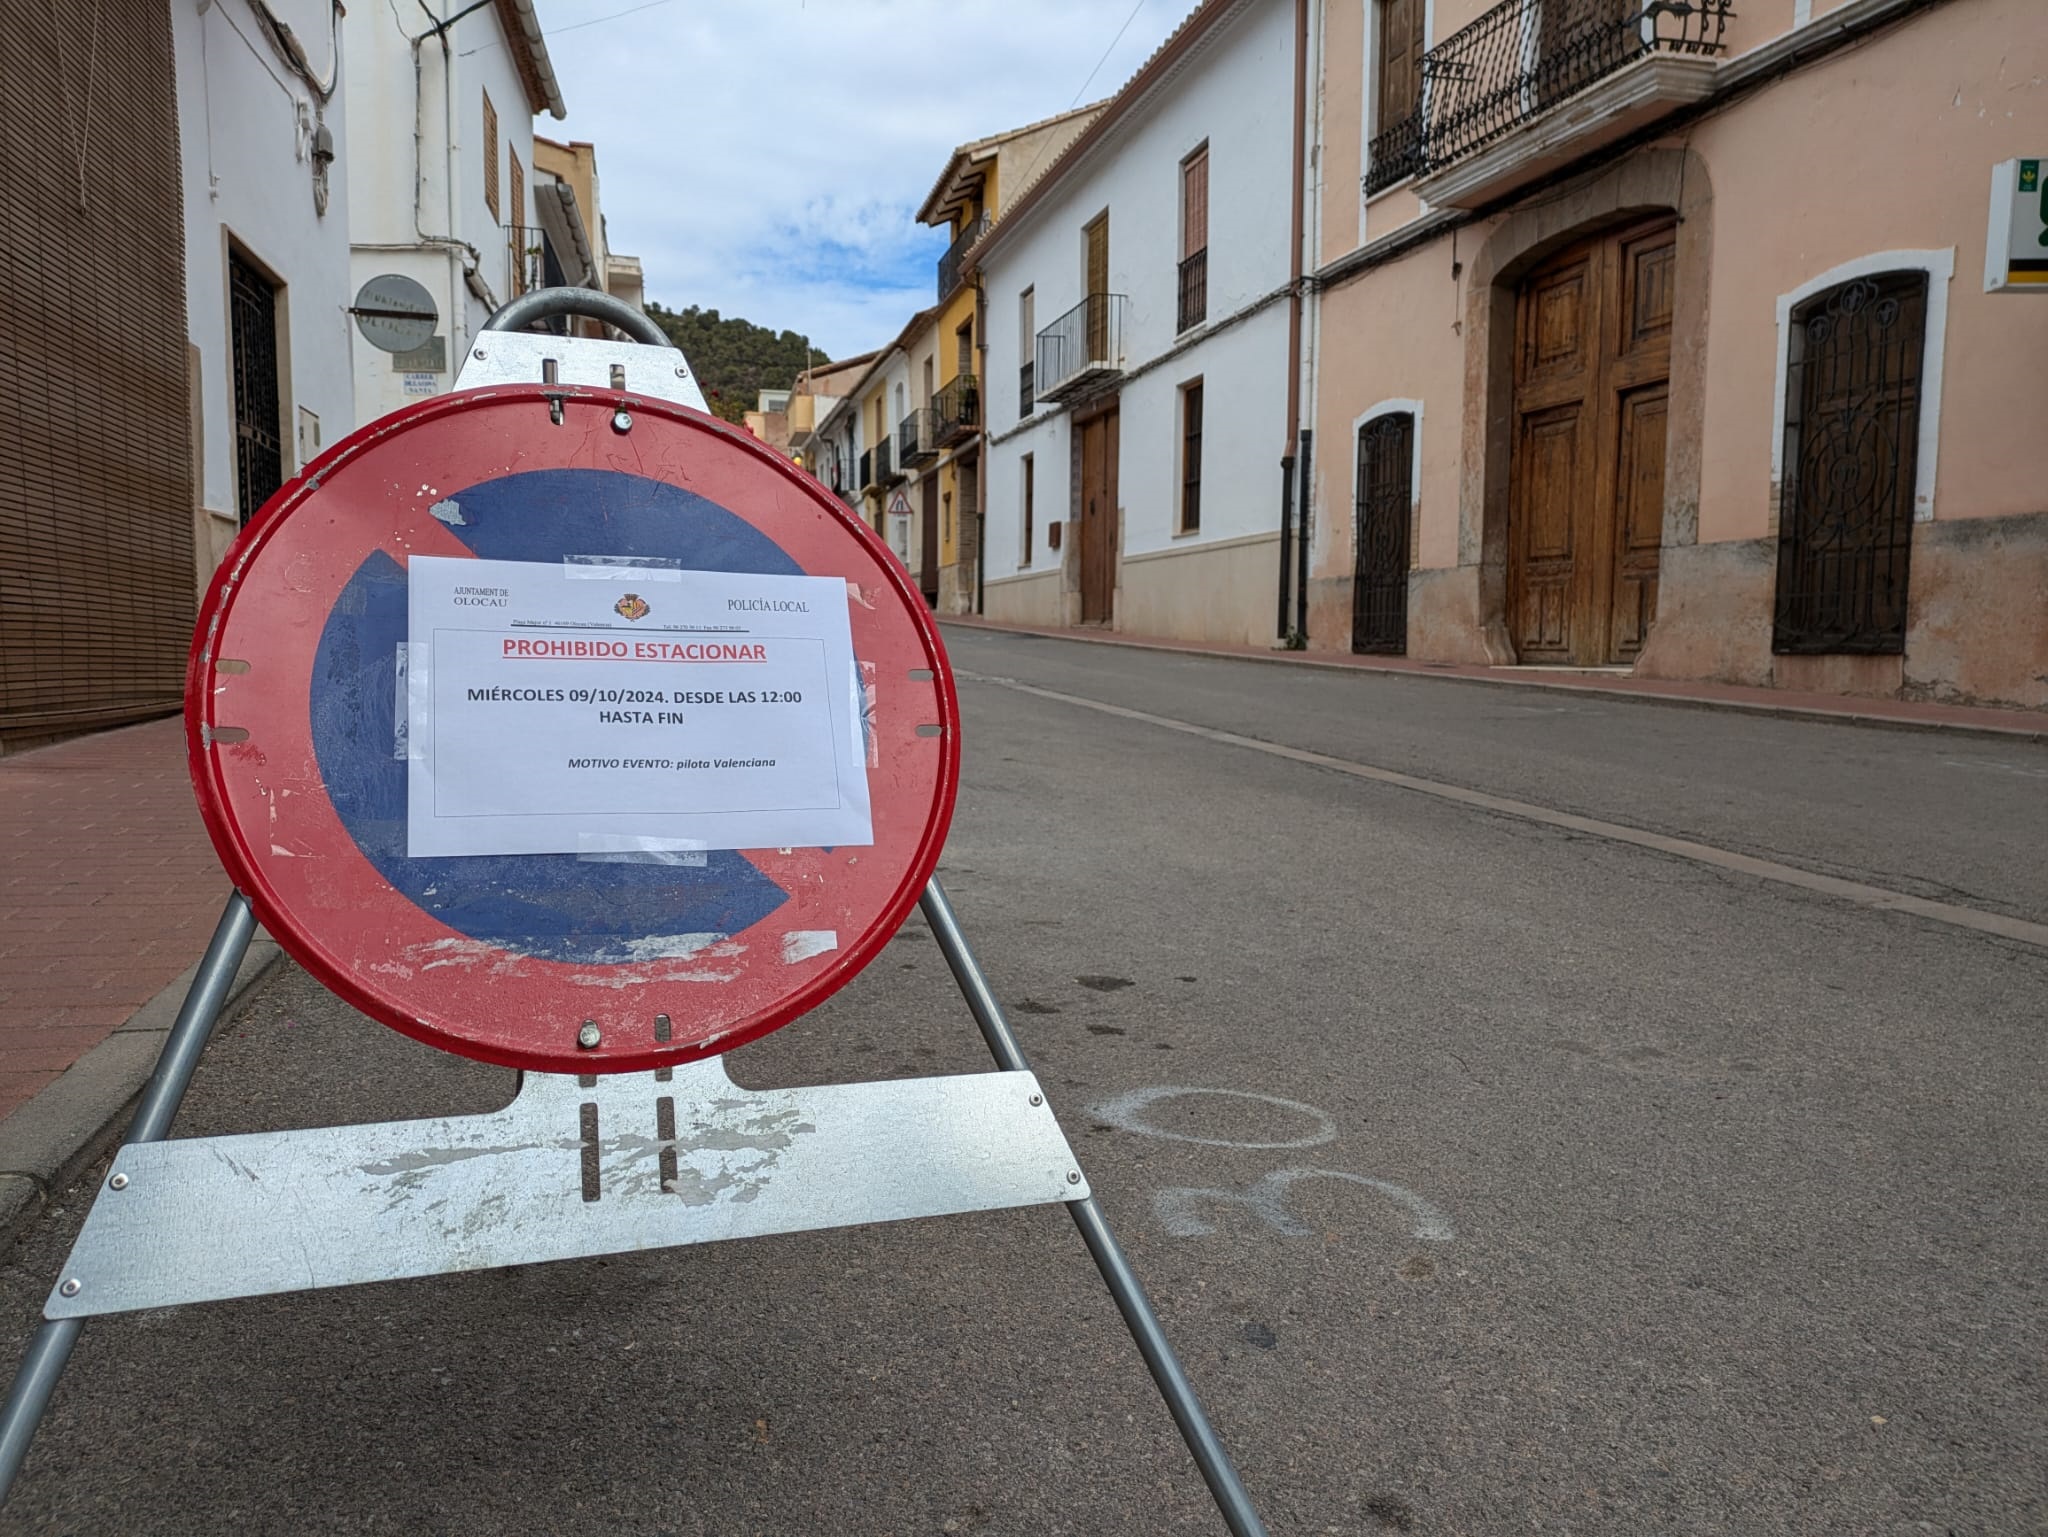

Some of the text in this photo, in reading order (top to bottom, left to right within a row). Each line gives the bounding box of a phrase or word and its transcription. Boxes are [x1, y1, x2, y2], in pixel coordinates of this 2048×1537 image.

[454, 587, 509, 597] AJUNTAMENT DE
[454, 597, 507, 607] OLOCAU
[727, 598, 809, 613] POLICÍA LOCAL
[503, 639, 767, 660] PROHIBIDO ESTACIONAR
[467, 686, 802, 704] MIÉRCOLES 09/10/2024. DESDE LAS 12:00
[599, 711, 684, 725] HASTA FIN
[568, 758, 776, 771] MOTIVO EVENTO: pilota Valenciana
